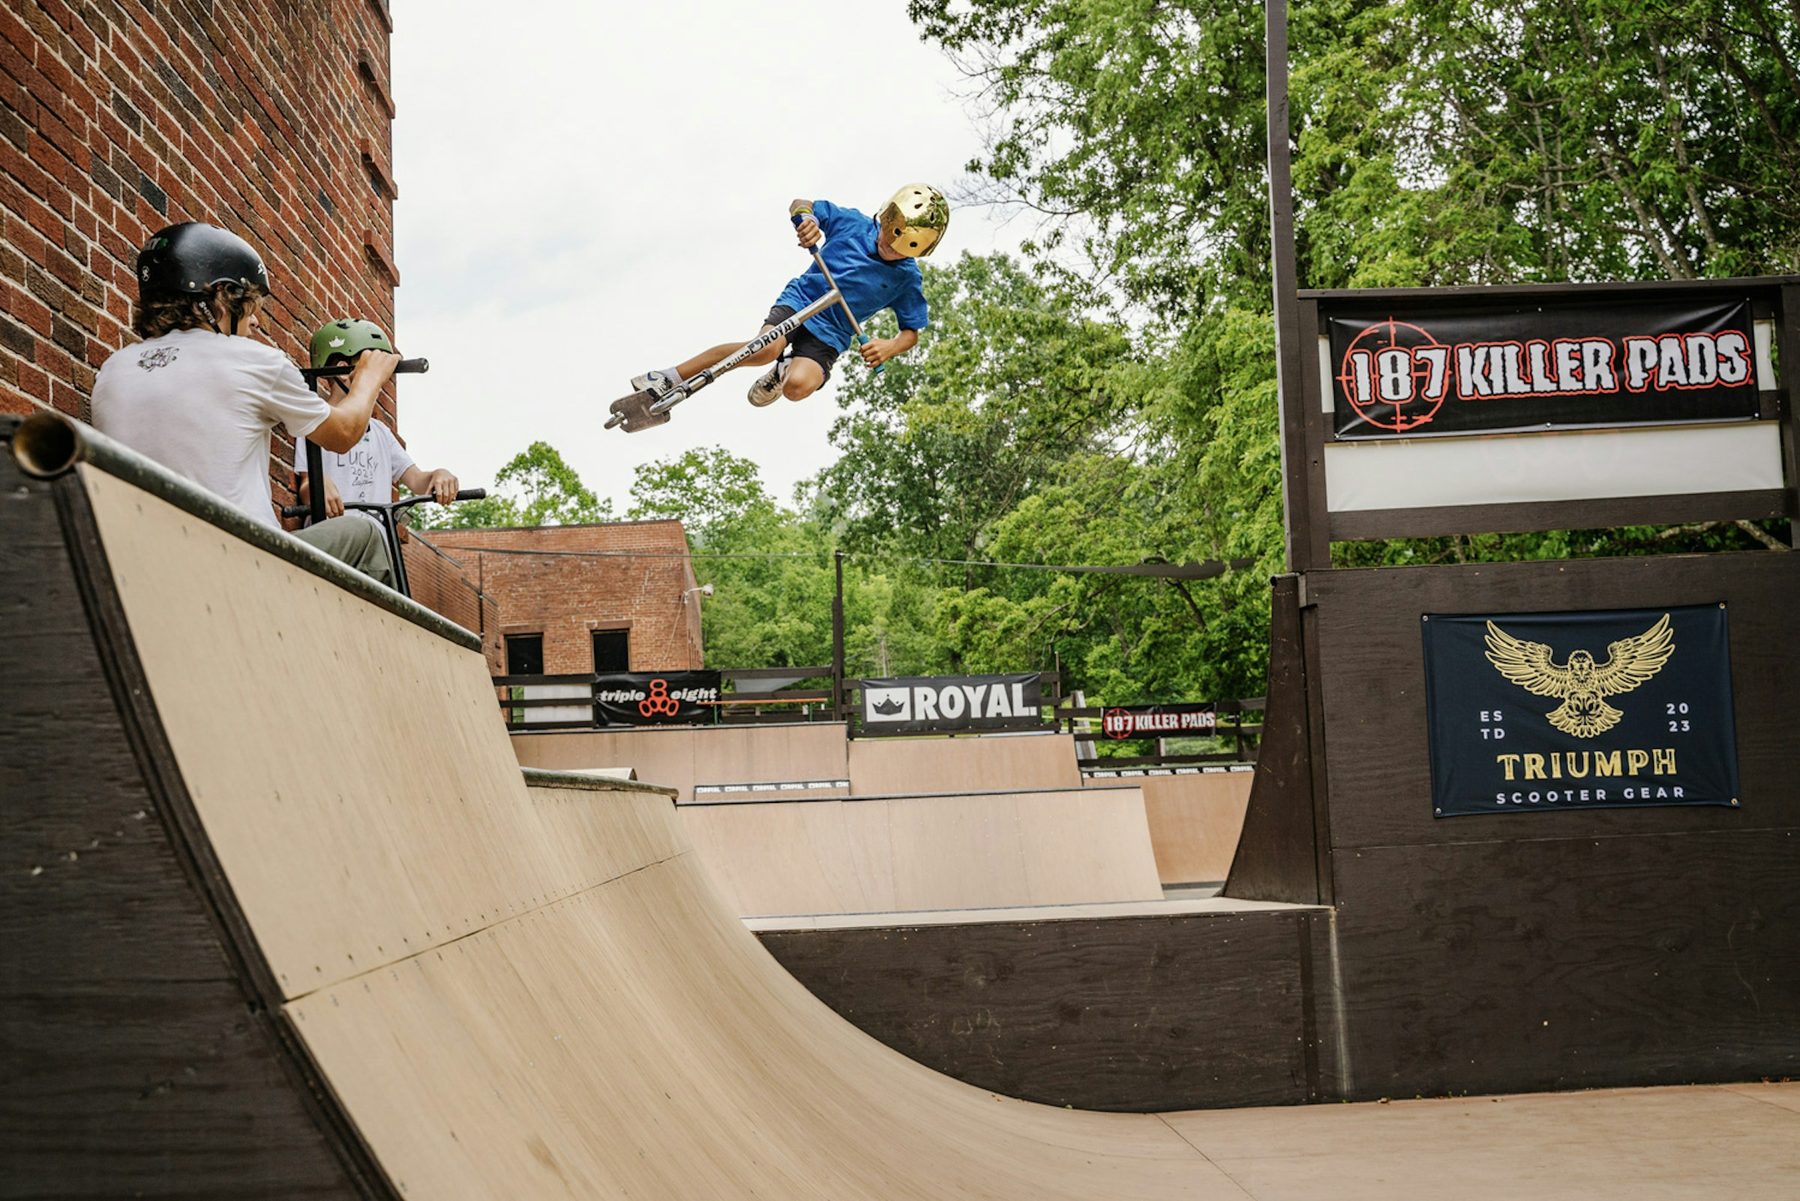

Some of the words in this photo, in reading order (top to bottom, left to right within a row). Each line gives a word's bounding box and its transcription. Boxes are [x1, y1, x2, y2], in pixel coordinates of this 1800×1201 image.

[1350, 347, 1449, 403] 187
[1456, 340, 1617, 398] KILLER
[1626, 330, 1750, 388] PADS
[600, 690, 646, 703] triple
[670, 688, 717, 702] eight
[1480, 710, 1503, 722] ES
[1666, 702, 1689, 715] 20
[1105, 716, 1133, 732] 187
[1135, 713, 1179, 731] KILLER
[1181, 711, 1216, 729] PADS
[1669, 720, 1691, 732] 23
[1481, 729, 1505, 740] TD
[1497, 748, 1677, 781] TRIUMPH
[1496, 789, 1607, 804] SCOOTER
[1623, 786, 1684, 799] GEAR
